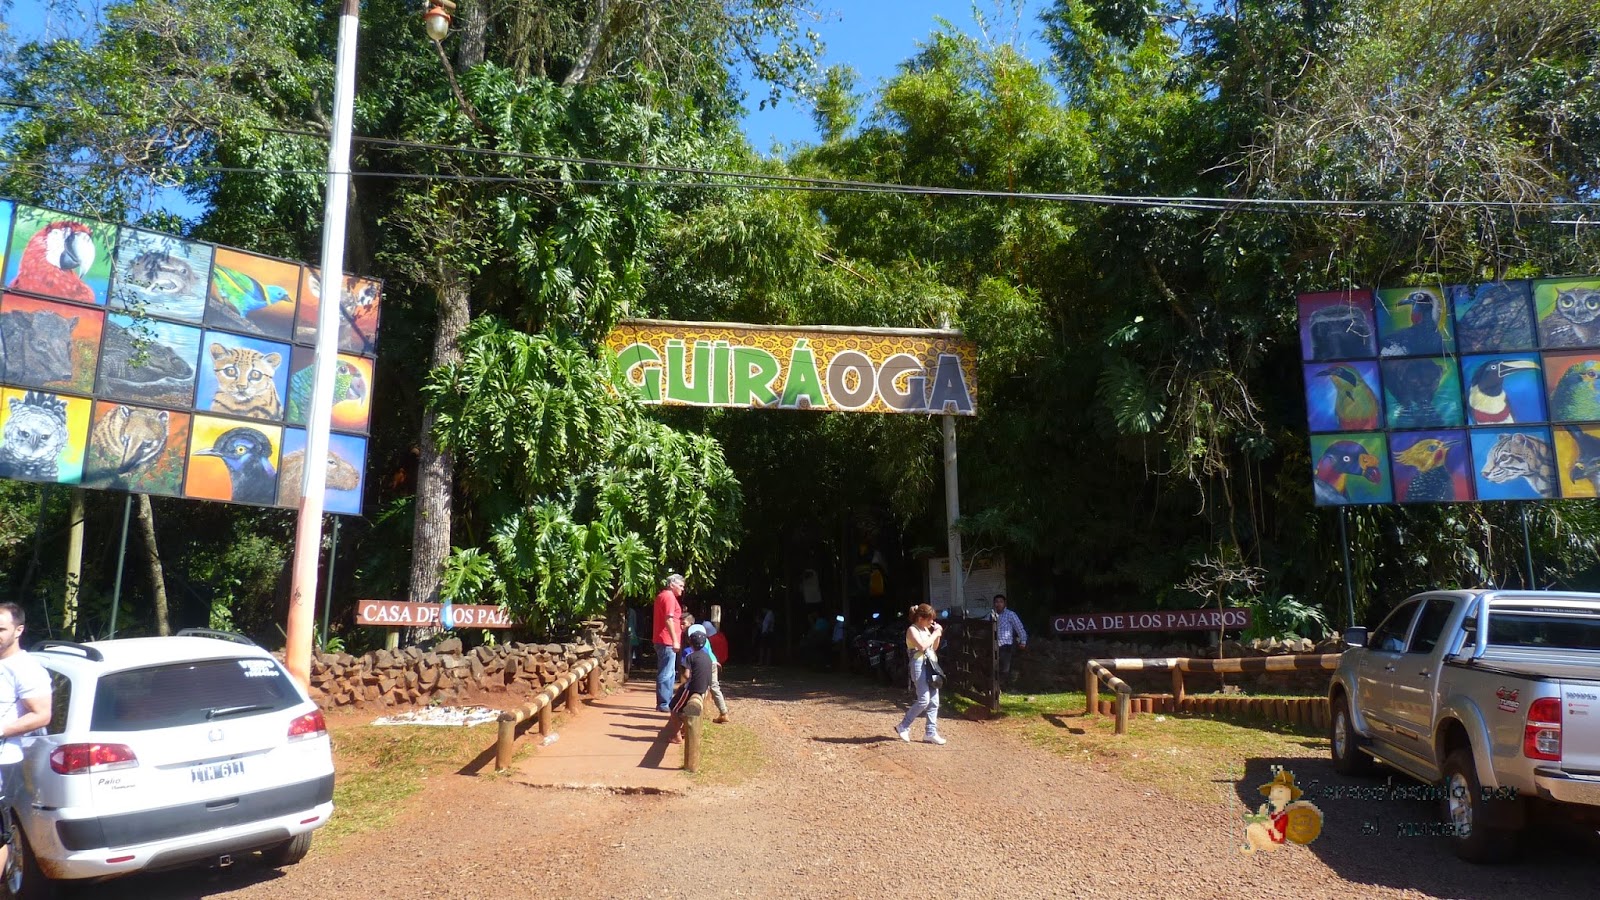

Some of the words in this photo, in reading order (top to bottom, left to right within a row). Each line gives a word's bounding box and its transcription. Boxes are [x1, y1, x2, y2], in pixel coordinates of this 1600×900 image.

[363, 604, 411, 622] CASA
[416, 606, 439, 623] DE
[452, 607, 474, 624] OS
[1054, 617, 1098, 632] CASA
[1102, 615, 1124, 630] DE
[1129, 614, 1161, 629] LOS
[1167, 611, 1247, 628] PAJAROS
[221, 761, 244, 777] 611
